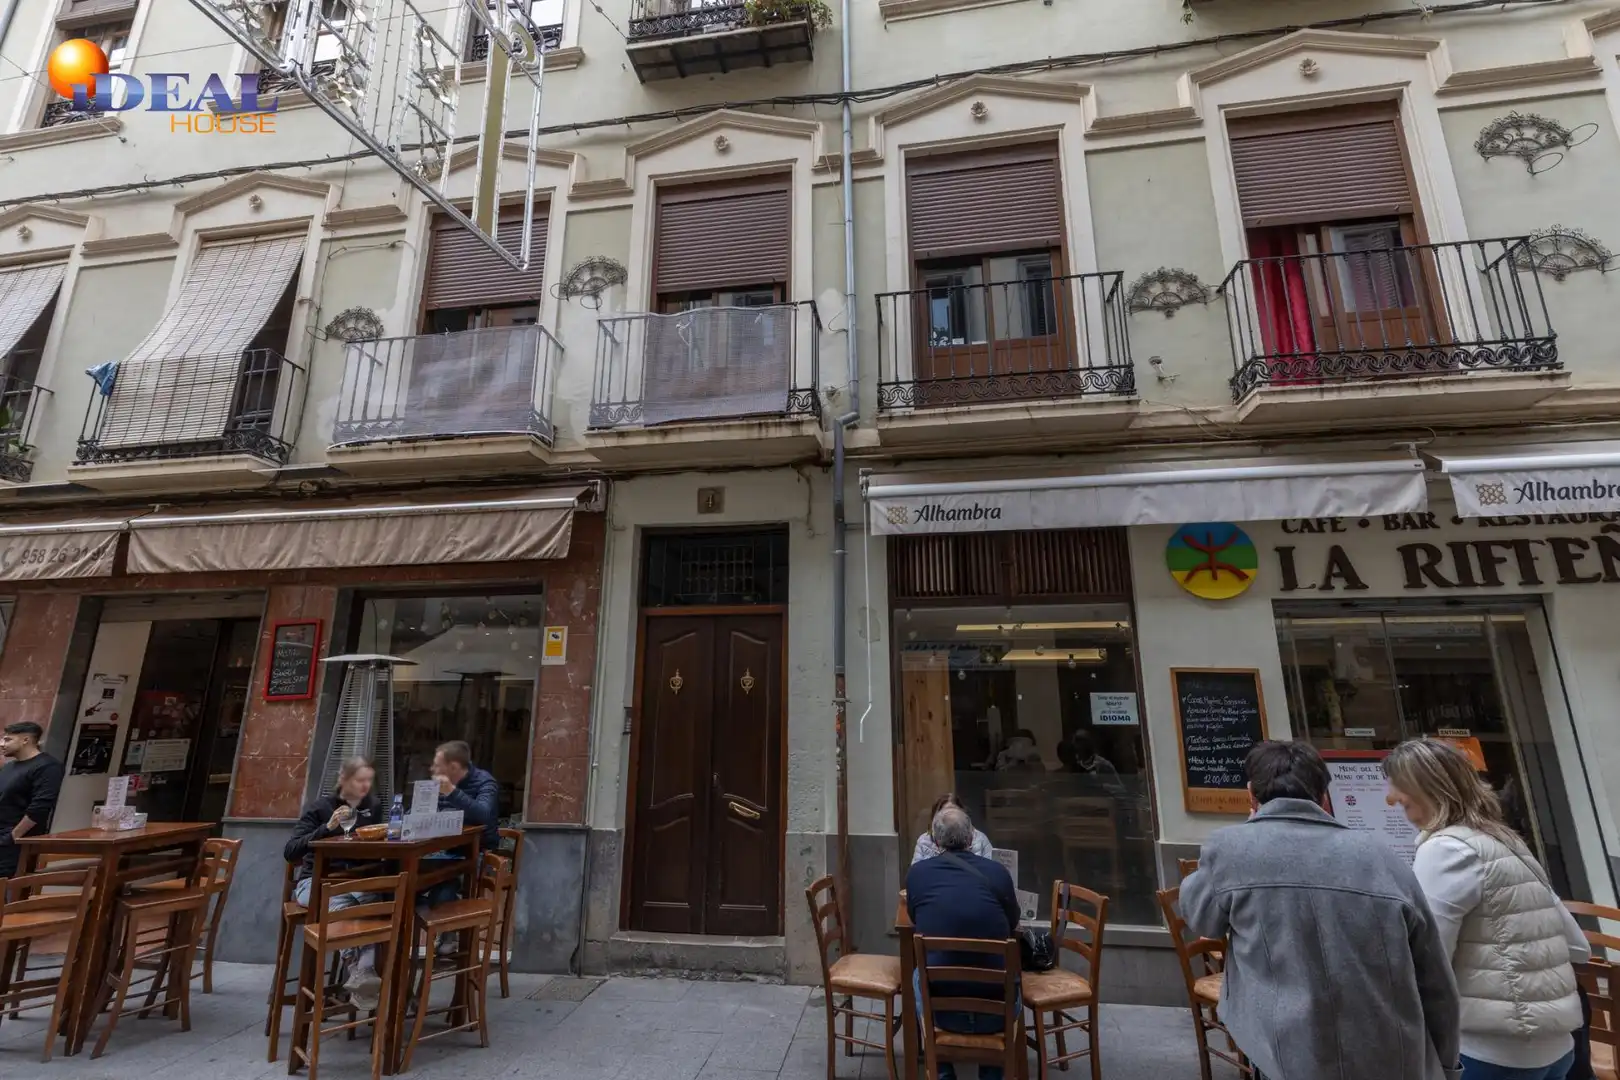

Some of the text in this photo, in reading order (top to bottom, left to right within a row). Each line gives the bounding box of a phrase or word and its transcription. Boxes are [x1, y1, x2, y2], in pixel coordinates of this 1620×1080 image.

[705, 494, 714, 508] 4
[1513, 477, 1620, 505] Alhambr
[913, 503, 1002, 524] Alhambra
[1382, 511, 1440, 531] BAR
[21, 548, 46, 564] 958
[48, 547, 68, 563] 26
[1274, 544, 1370, 591] LA
[1100, 714, 1131, 722] IDIOMA
